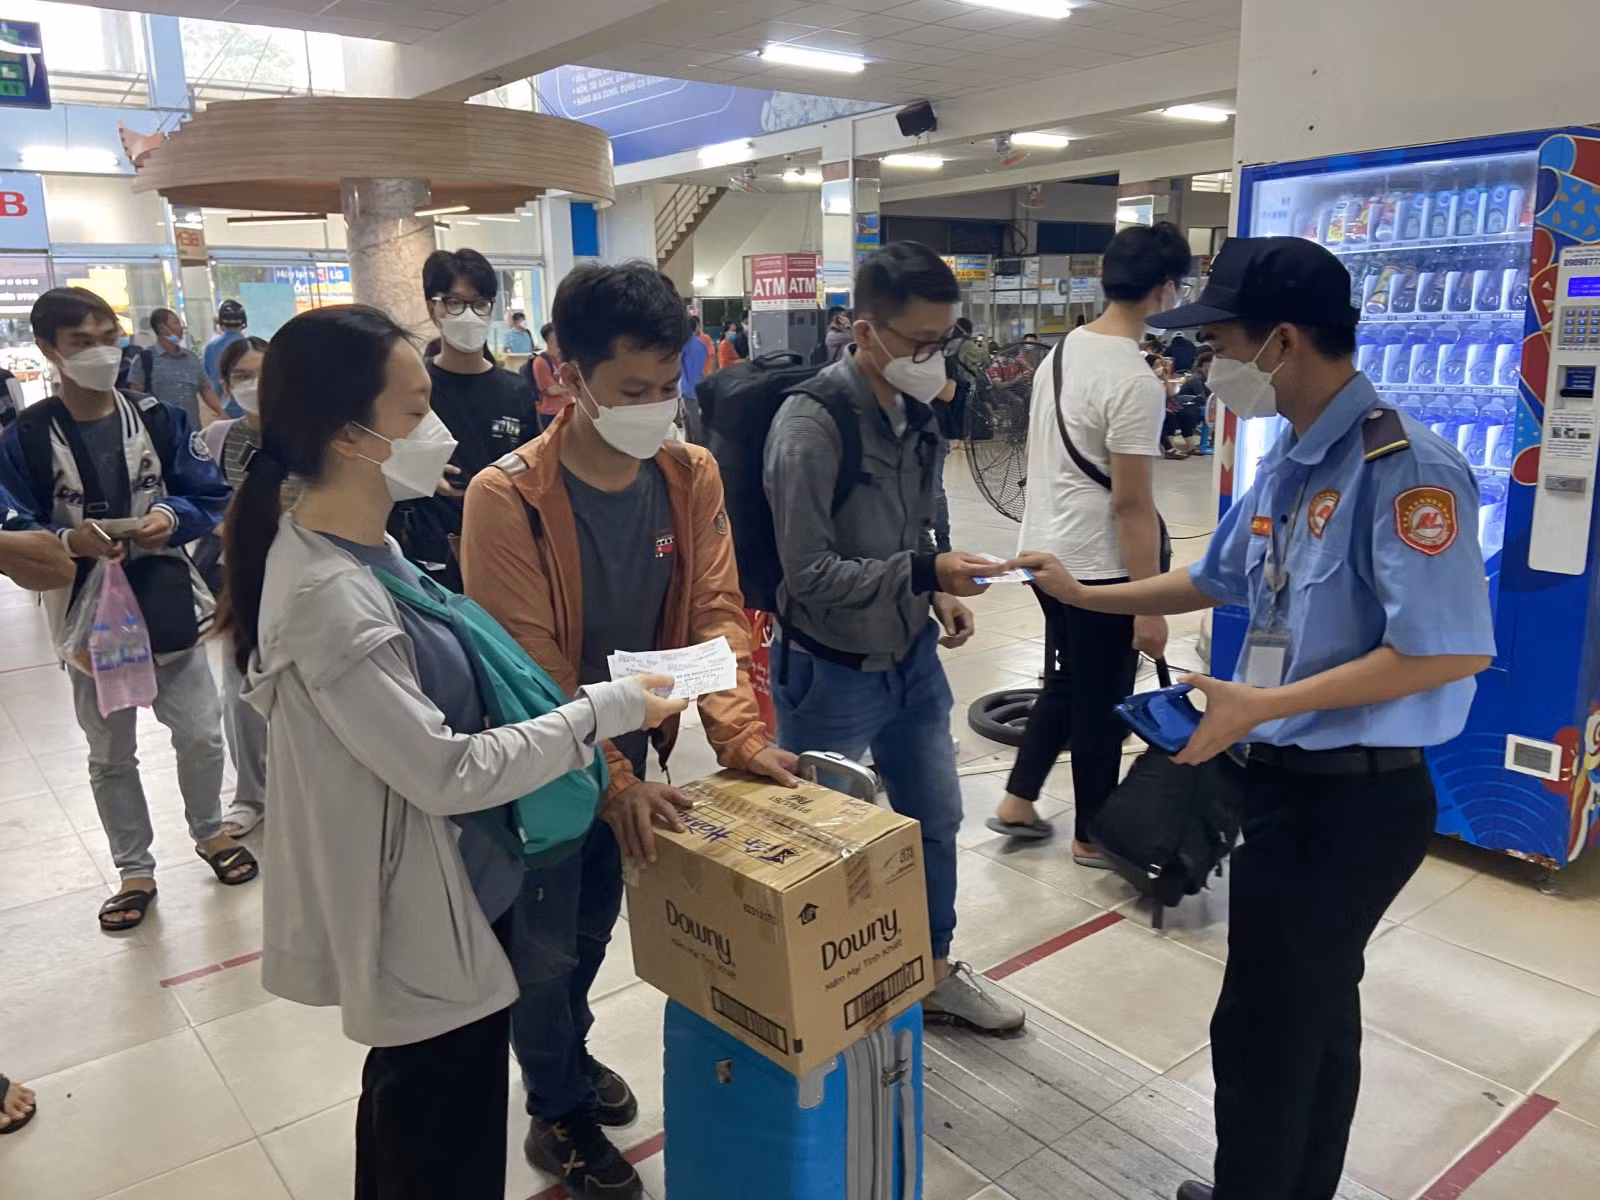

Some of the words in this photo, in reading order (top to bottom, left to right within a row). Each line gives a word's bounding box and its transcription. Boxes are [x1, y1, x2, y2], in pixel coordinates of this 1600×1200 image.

[329, 268, 345, 281] LG
[789, 276, 816, 294] ATM
[753, 276, 786, 297] ATM
[665, 898, 732, 965] Downy
[821, 908, 898, 971] Downy
